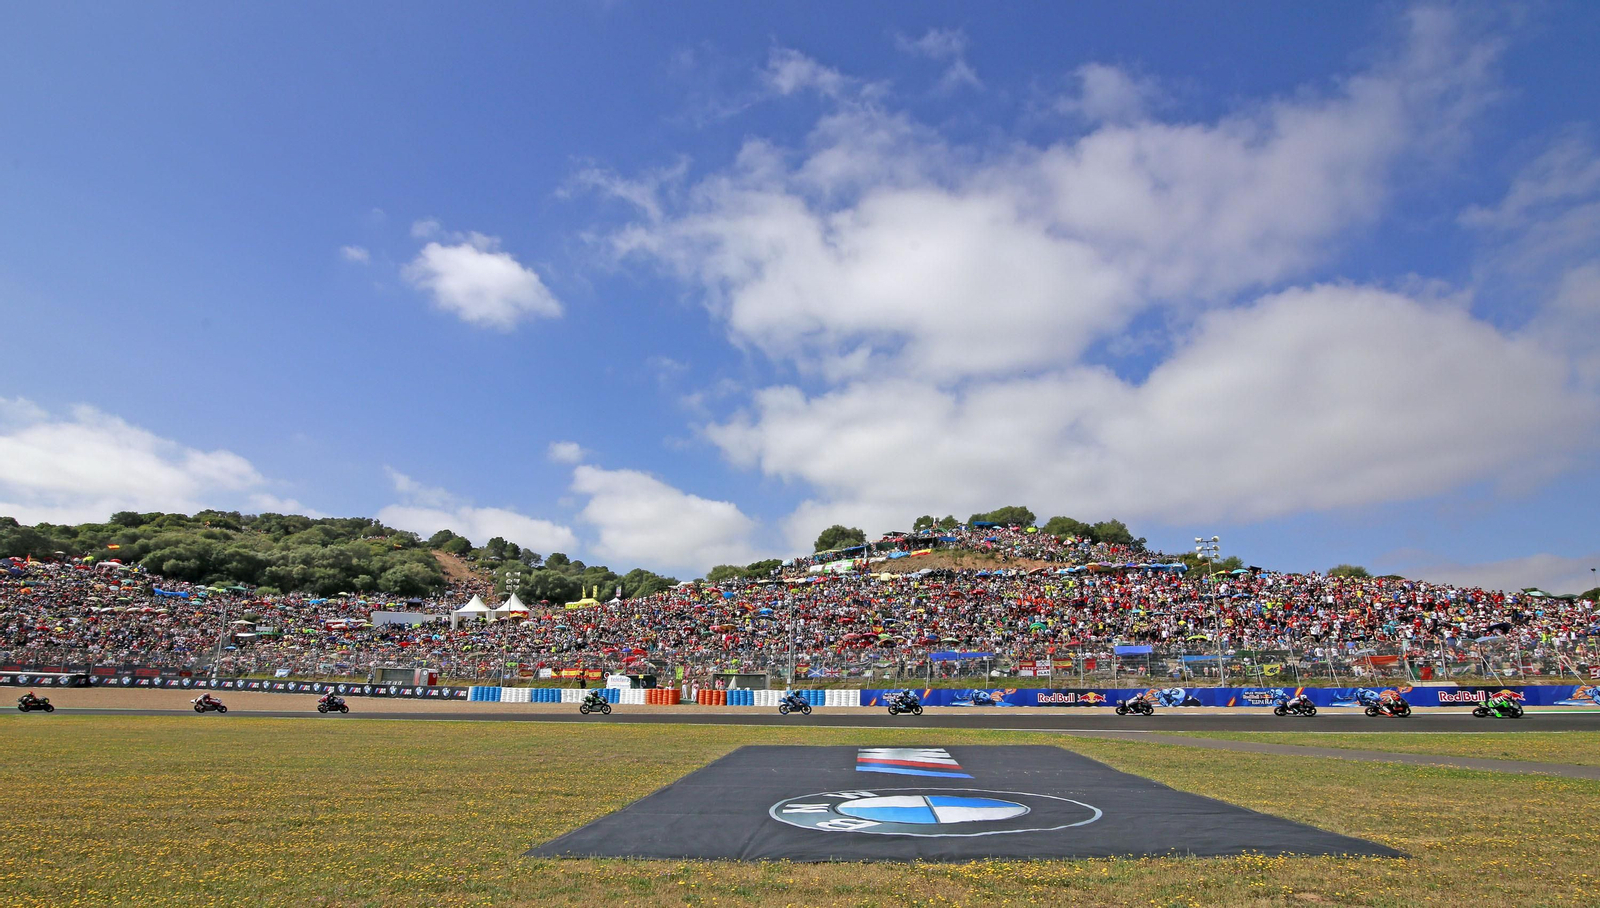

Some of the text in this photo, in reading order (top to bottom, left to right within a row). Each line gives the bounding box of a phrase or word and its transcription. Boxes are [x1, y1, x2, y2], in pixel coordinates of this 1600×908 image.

[1037, 693, 1075, 703] Red Bull
[1437, 691, 1485, 702] Red Bull
[857, 748, 961, 767] M
[782, 791, 882, 831] BMW
